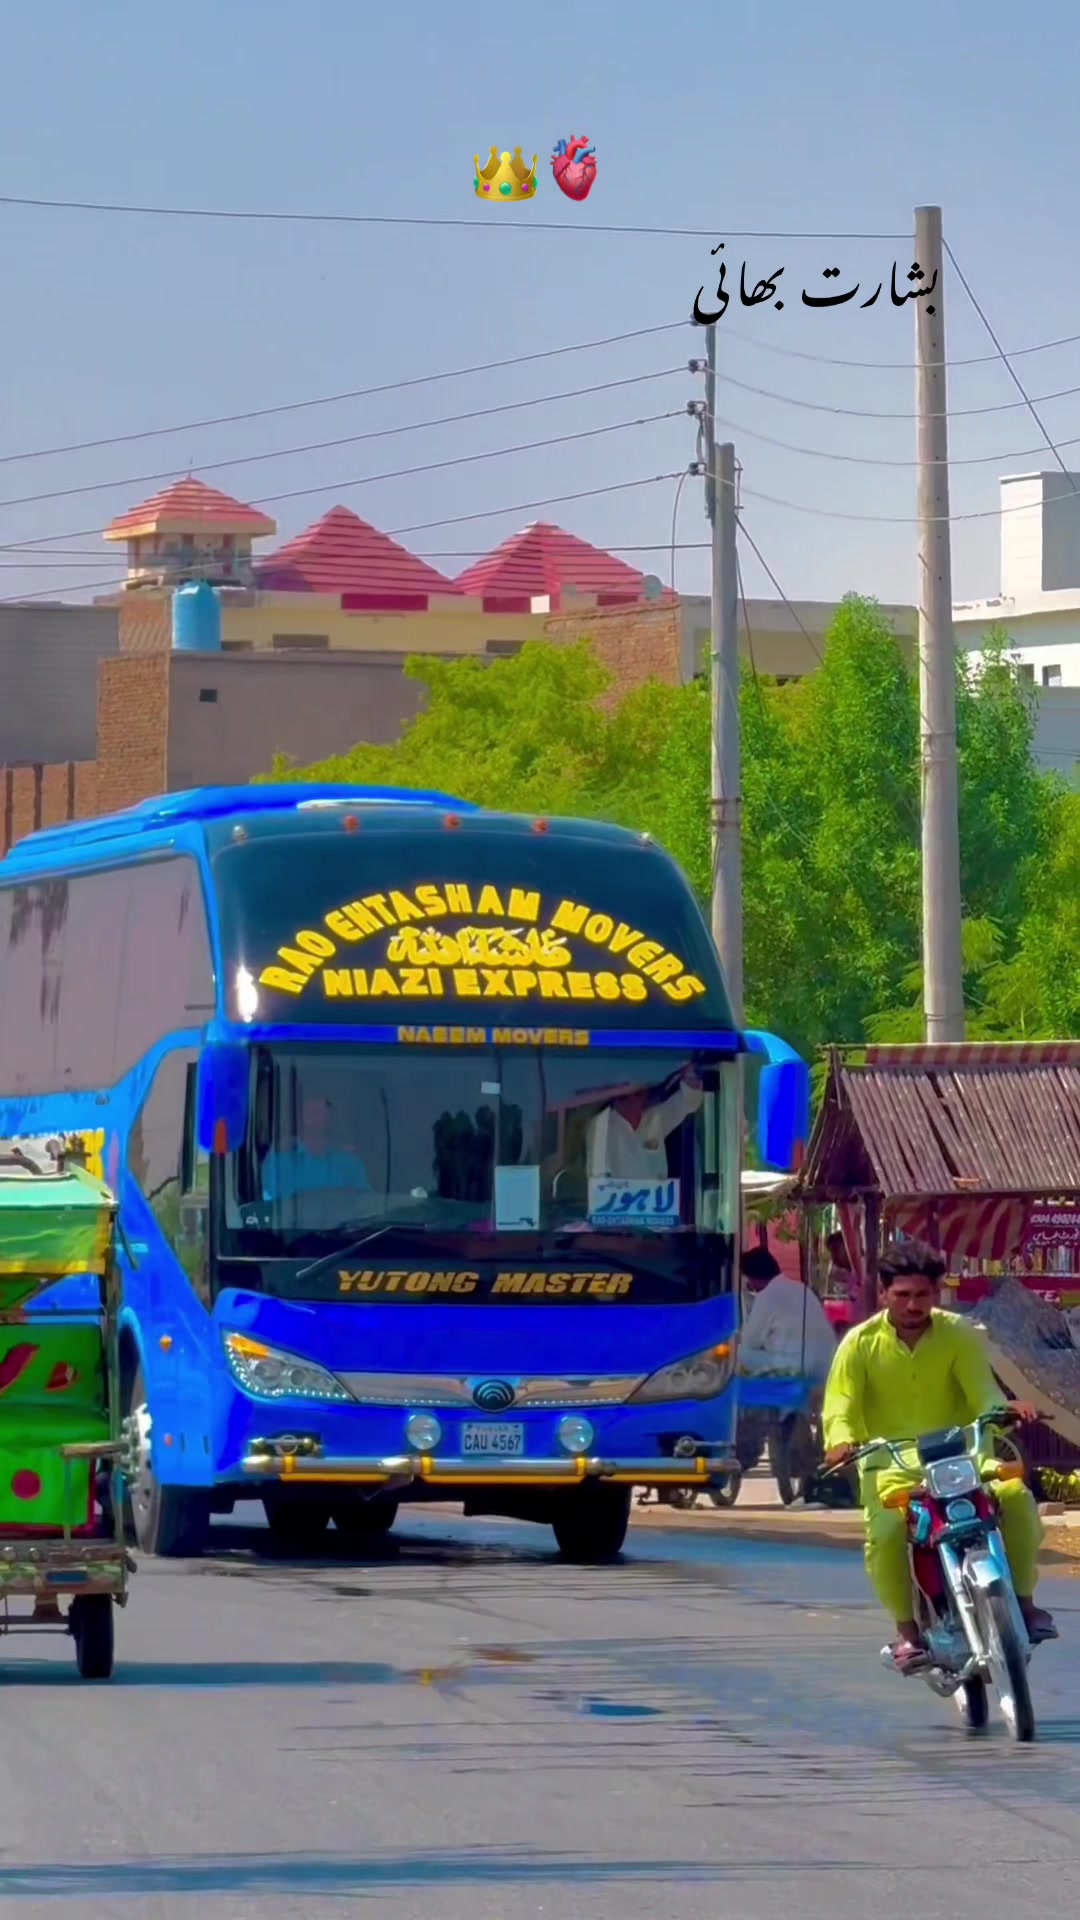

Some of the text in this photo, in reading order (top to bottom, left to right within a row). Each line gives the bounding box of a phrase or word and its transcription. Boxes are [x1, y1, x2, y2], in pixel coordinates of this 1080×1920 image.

[259, 883, 706, 1001] RAO EHTASHAM MOVERS
[322, 968, 648, 1001] NIAZI EXPRESS
[398, 1025, 590, 1046] NAEEM MOVERS
[595, 1180, 675, 1213] لاہور
[338, 1270, 634, 1294] YUTONG MASTER
[464, 1434, 522, 1451] CAU 4567
